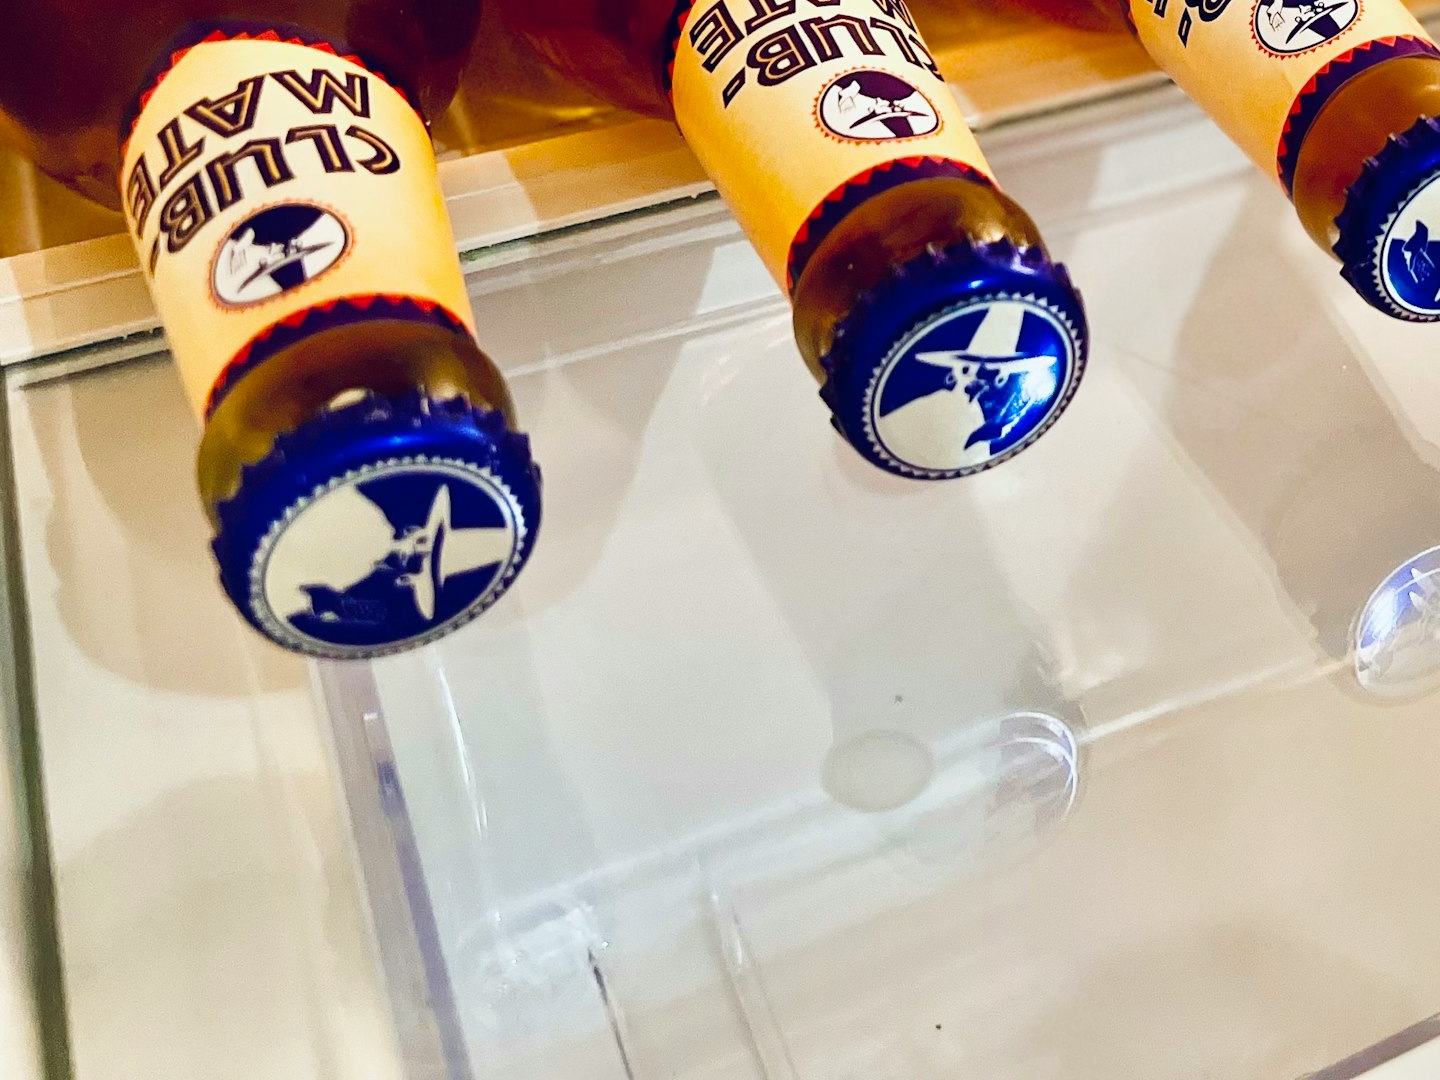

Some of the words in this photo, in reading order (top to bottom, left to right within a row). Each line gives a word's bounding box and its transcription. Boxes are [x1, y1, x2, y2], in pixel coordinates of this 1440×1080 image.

[722, 14, 946, 109] CLUB-
[126, 68, 371, 240] MATE
[149, 124, 401, 279] CLUB-
